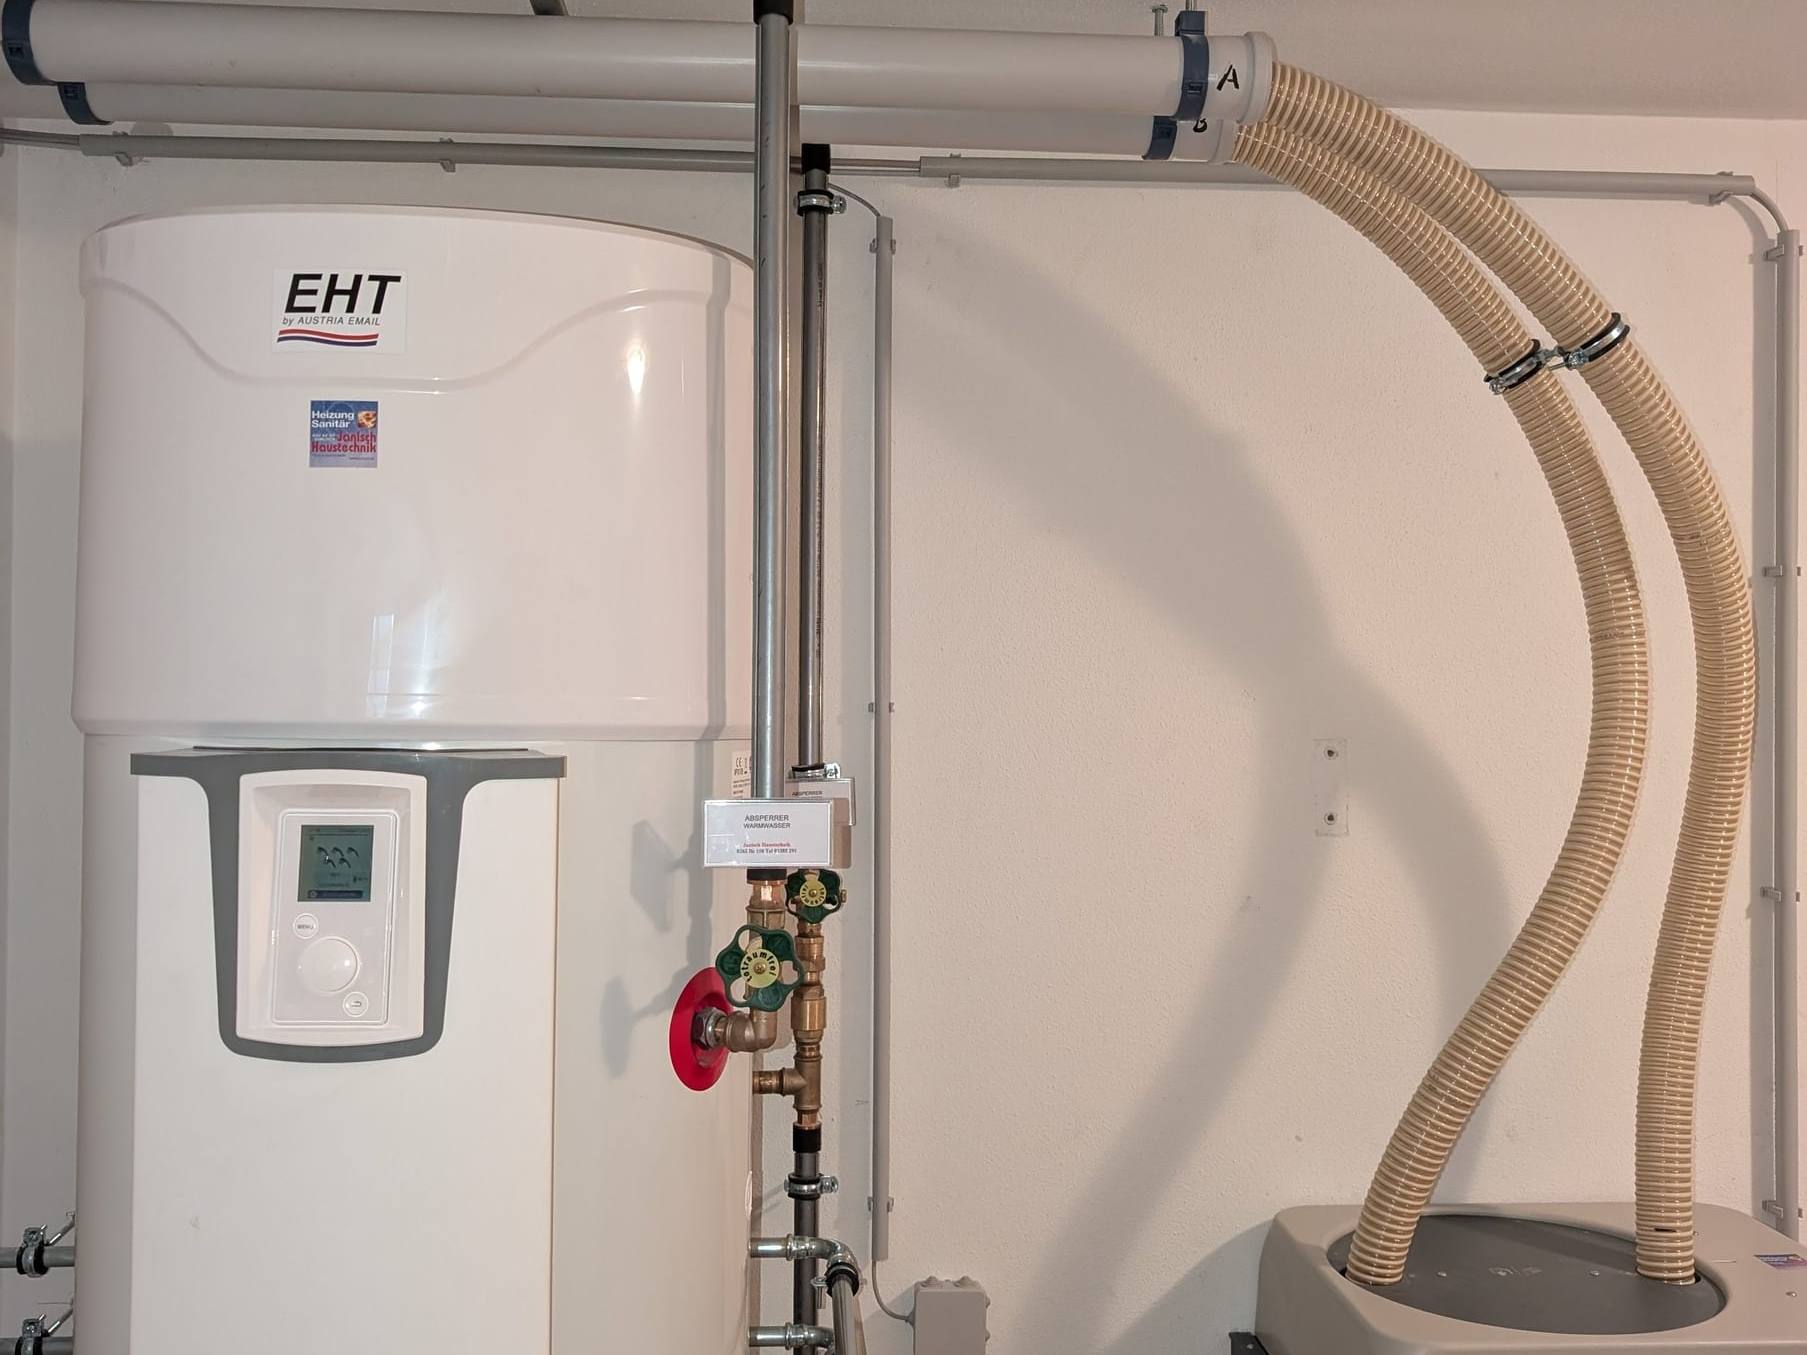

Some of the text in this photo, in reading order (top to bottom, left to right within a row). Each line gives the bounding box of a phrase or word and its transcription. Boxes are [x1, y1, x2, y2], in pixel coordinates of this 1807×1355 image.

[1216, 64, 1240, 91] A
[285, 273, 402, 314] EHT
[282, 316, 381, 326] by AUSTRIA EMAIL
[311, 410, 355, 421] Heizung
[311, 419, 351, 428] Sanitär
[337, 431, 377, 443] Janisch
[311, 440, 377, 453] Haustechnik
[744, 814, 790, 822] ABSPERRER
